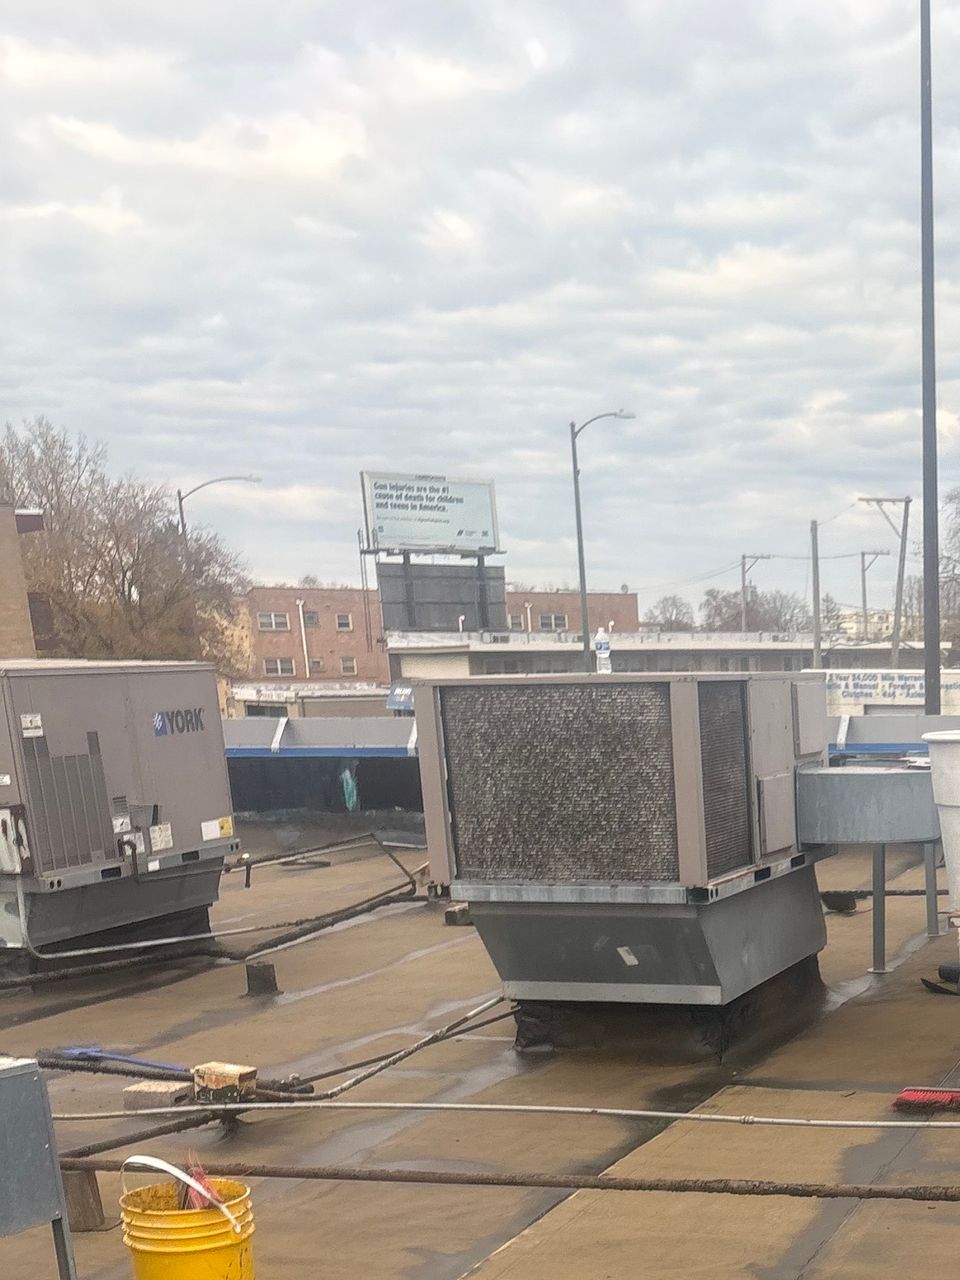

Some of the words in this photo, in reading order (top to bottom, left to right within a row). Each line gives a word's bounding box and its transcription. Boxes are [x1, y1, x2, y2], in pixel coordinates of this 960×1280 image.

[389, 482, 414, 492] injuries
[428, 485, 440, 493] the
[395, 492, 403, 501] of
[404, 493, 424, 502] death
[425, 494, 435, 502] for
[436, 495, 464, 504] children
[390, 502, 409, 511] teens
[410, 503, 418, 511] in
[166, 708, 204, 735] YORK
